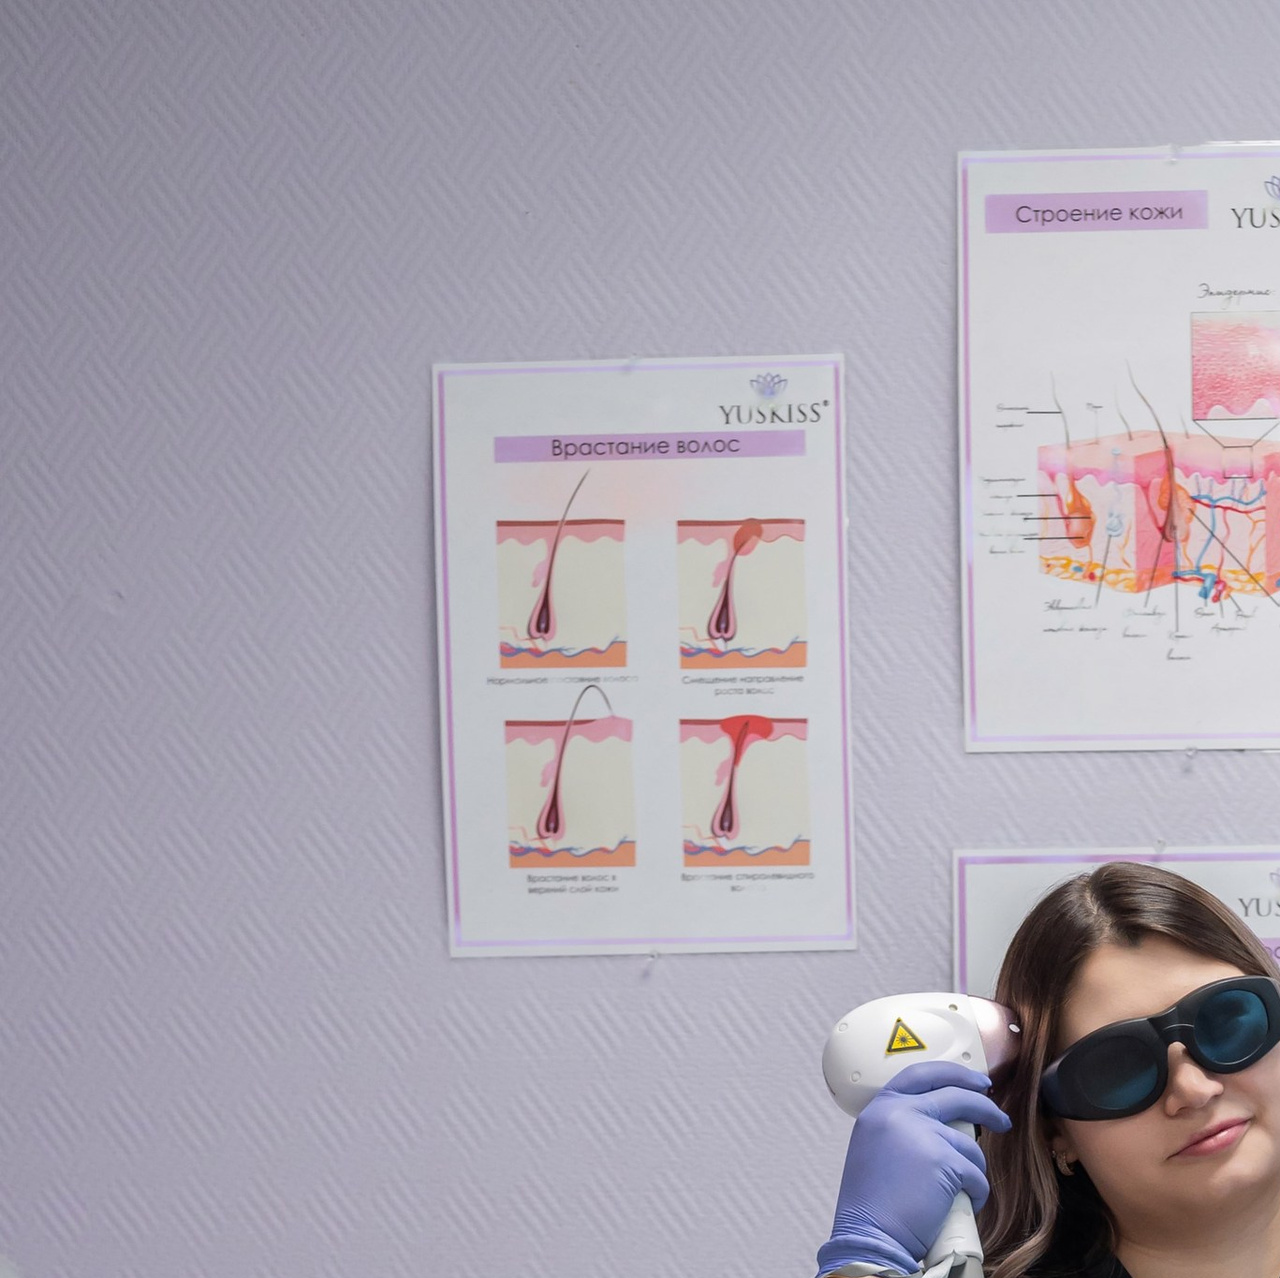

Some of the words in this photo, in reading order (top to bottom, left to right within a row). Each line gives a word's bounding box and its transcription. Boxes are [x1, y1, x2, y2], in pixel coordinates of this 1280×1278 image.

[1016, 205, 1123, 226] Строение
[1129, 204, 1184, 221] кожи
[551, 438, 670, 460] Врастание
[676, 438, 741, 453] волос
